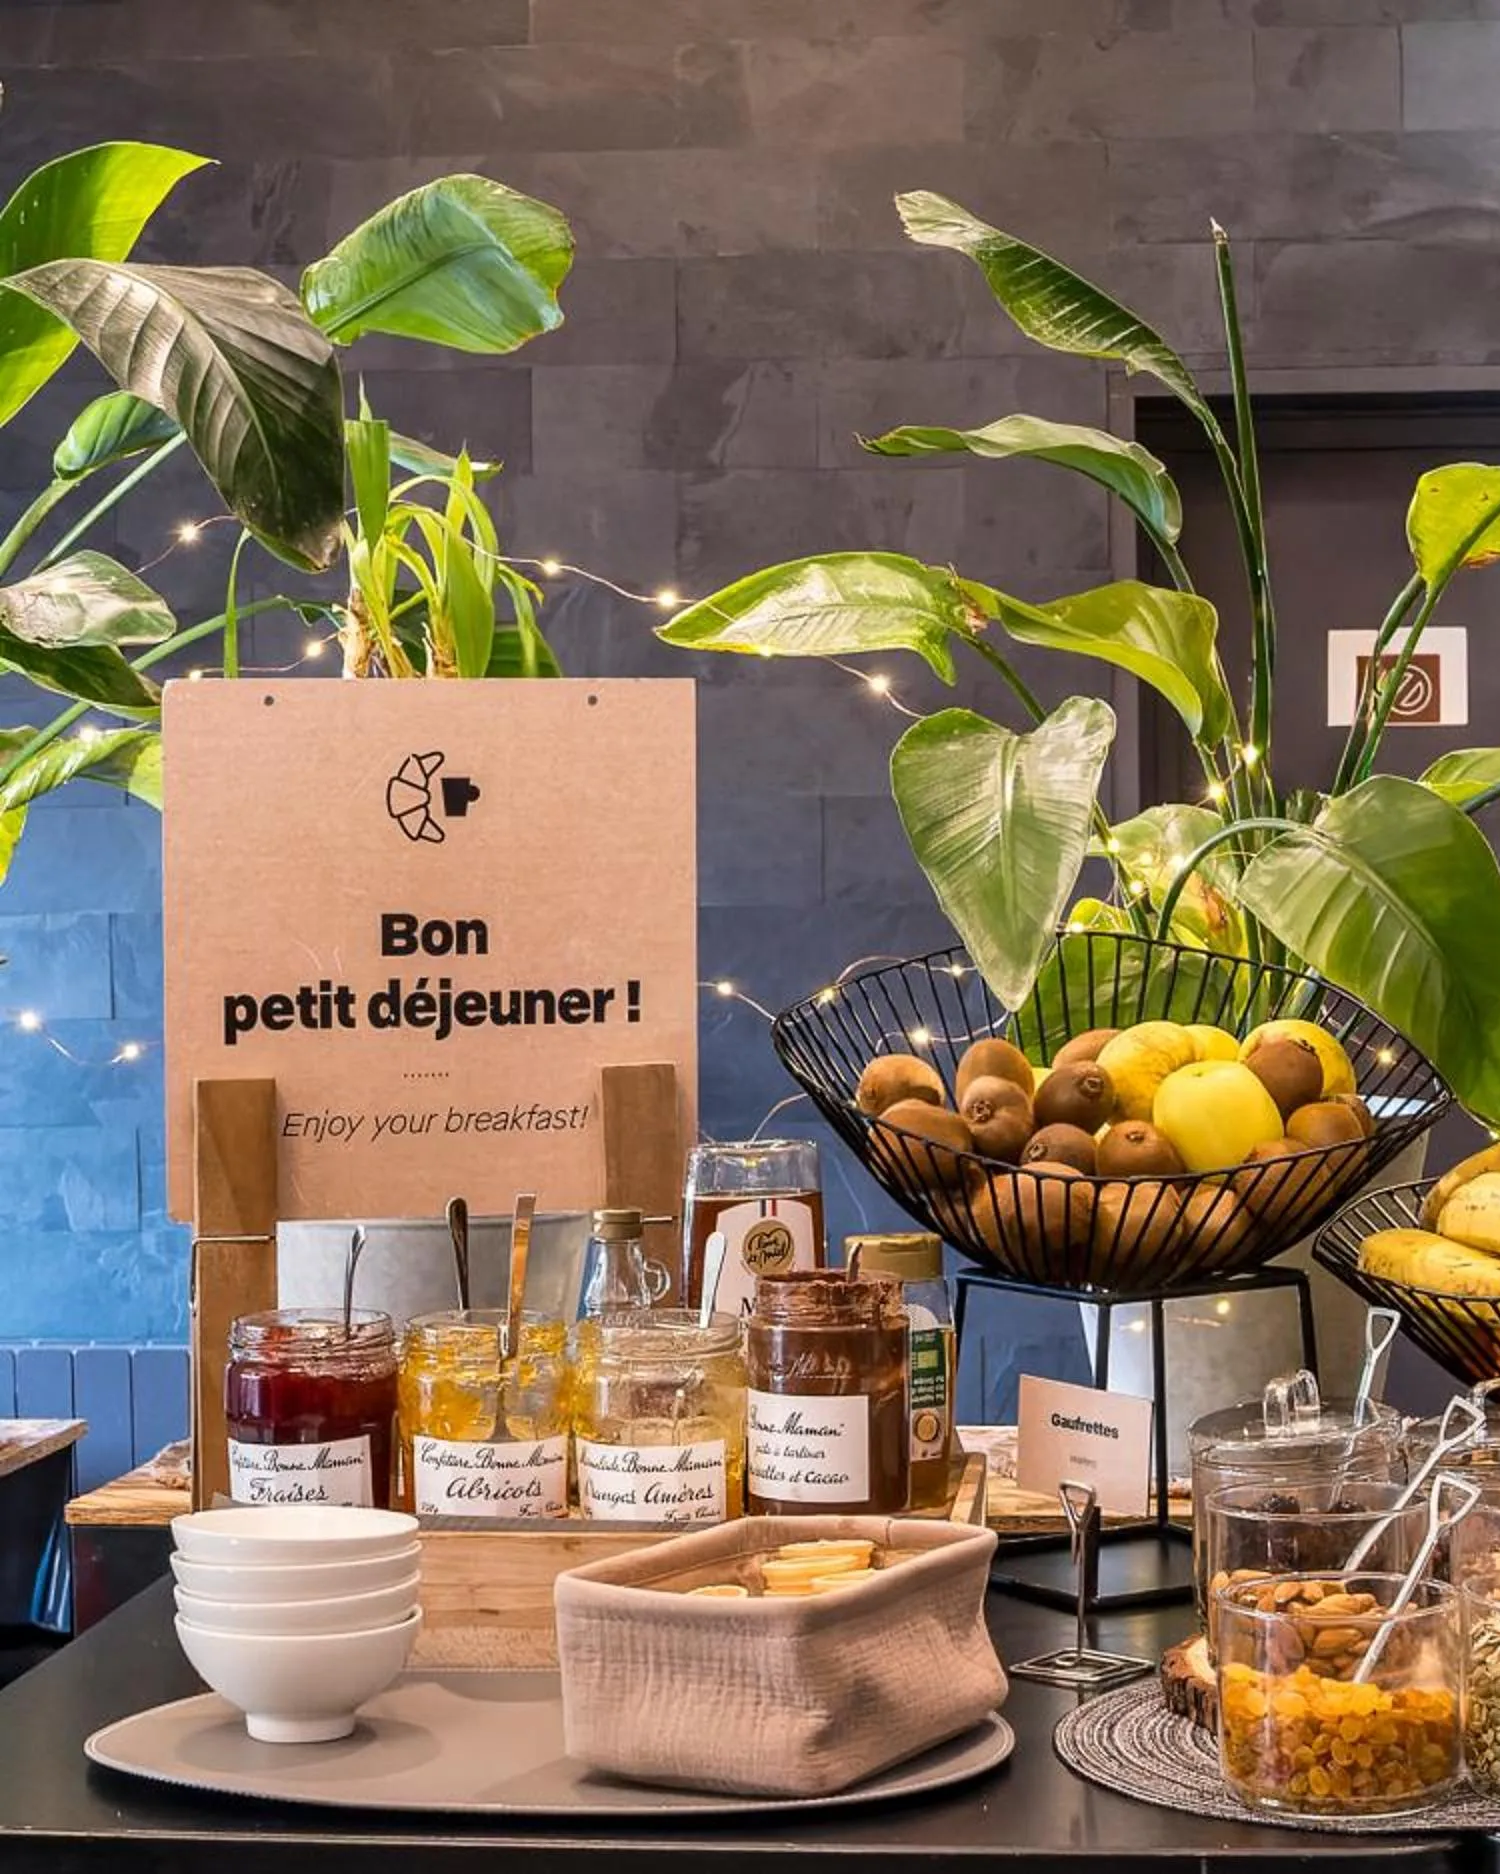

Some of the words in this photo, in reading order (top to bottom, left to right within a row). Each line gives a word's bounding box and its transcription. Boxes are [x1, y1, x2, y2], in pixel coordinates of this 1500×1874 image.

[380, 913, 490, 957] Bon
[223, 978, 356, 1046] petit
[367, 977, 614, 1041] déjeuner
[627, 980, 641, 1023] !
[282, 1112, 366, 1143] Enjoy
[371, 1113, 437, 1142] your
[444, 1105, 589, 1134] breakfast!
[1050, 1411, 1121, 1440] Gaufrettes
[249, 1476, 331, 1504] Fraises
[445, 1475, 542, 1501] Abricots
